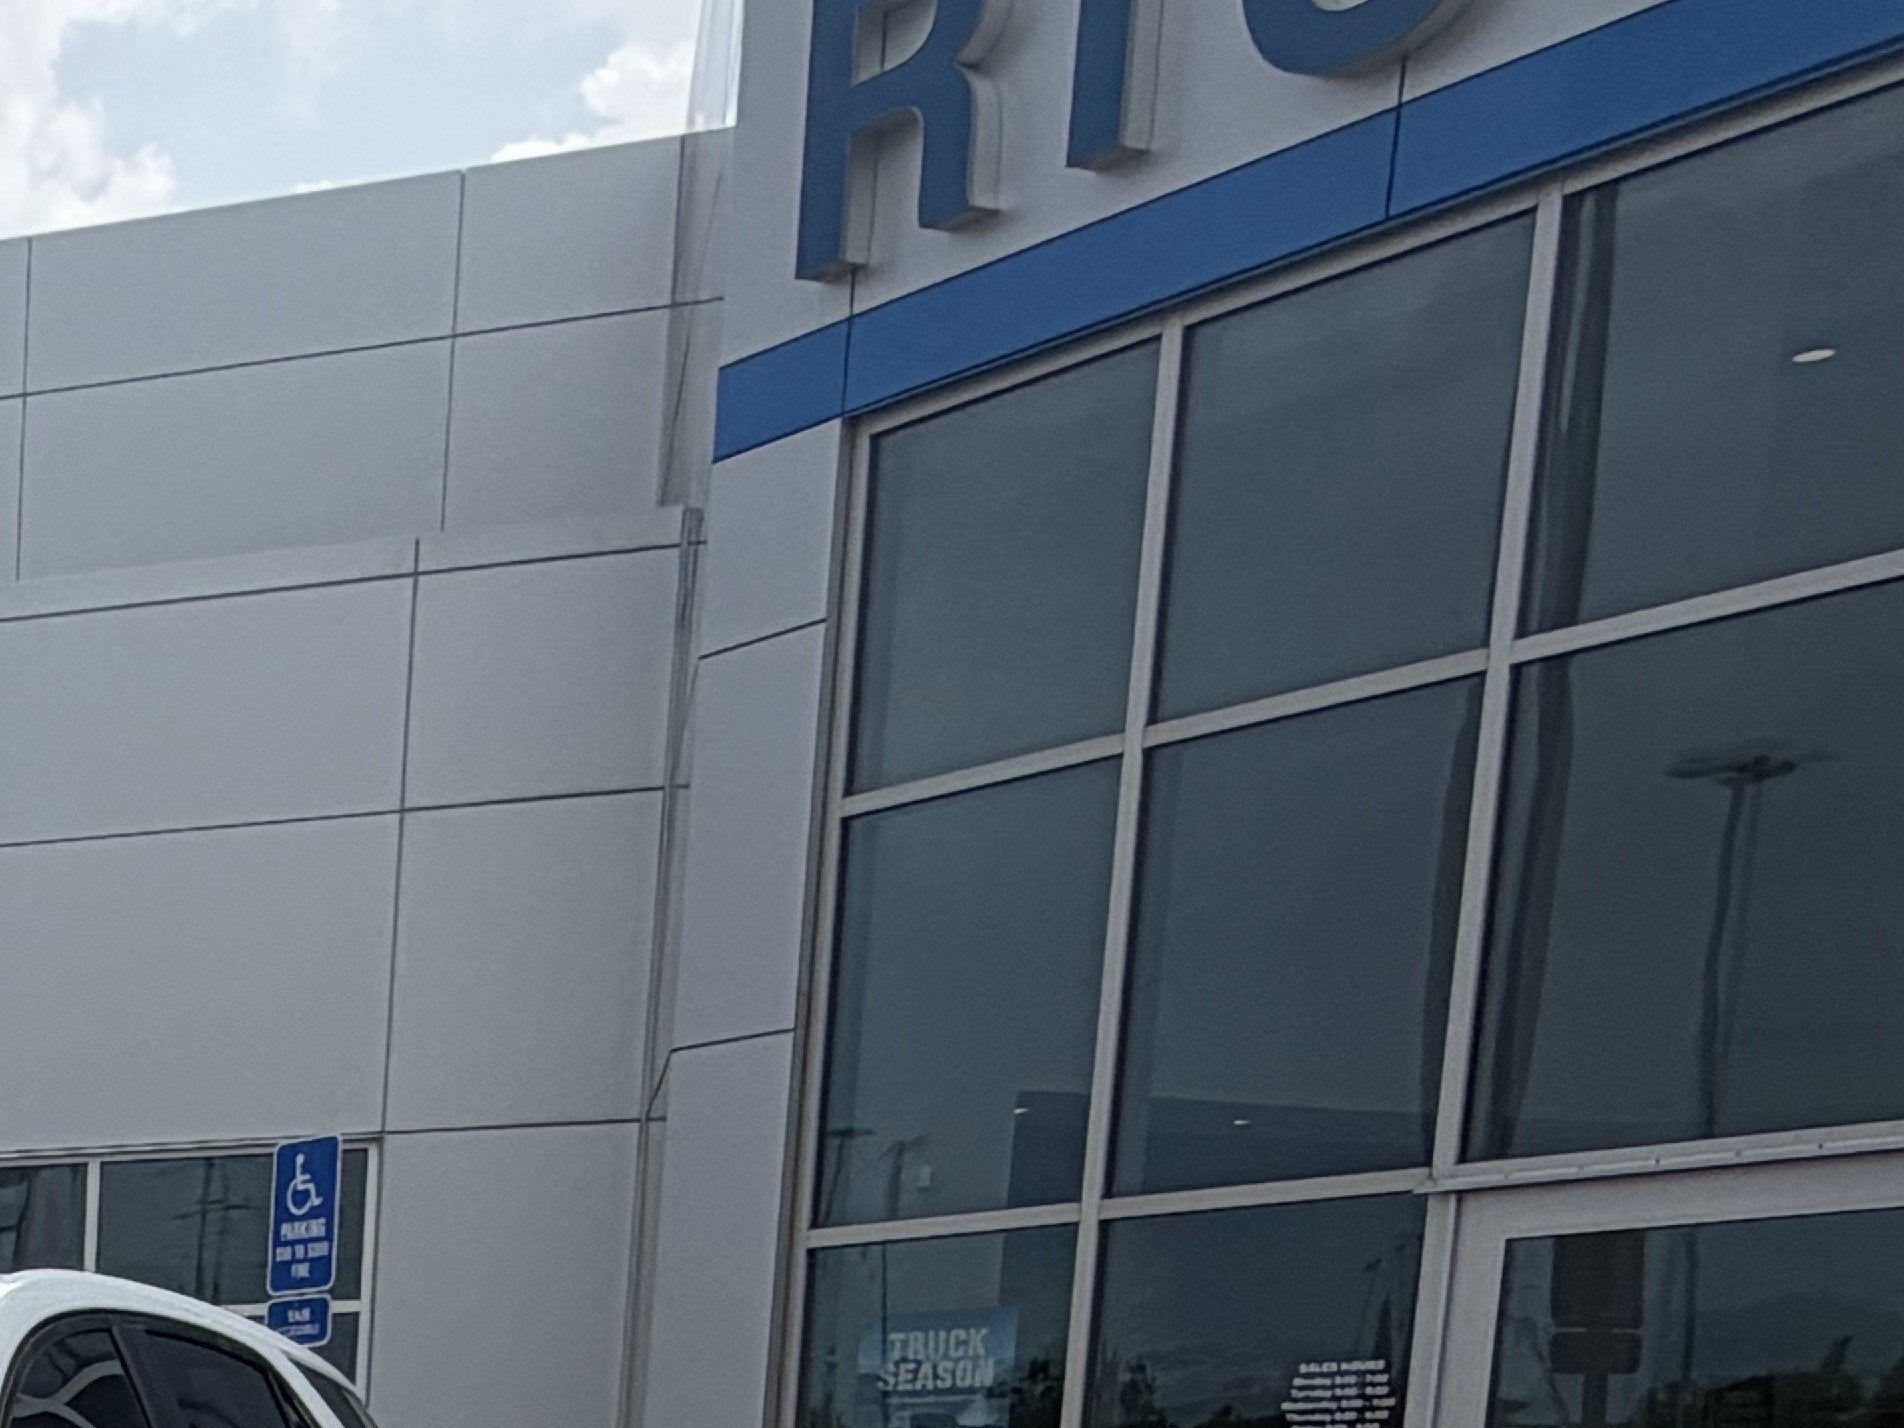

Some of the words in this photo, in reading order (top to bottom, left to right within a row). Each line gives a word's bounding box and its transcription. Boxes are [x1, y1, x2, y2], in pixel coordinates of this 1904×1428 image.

[795, 0, 1460, 281] RI
[889, 1328, 988, 1361] TRUCK
[877, 1360, 995, 1391] SEASON
